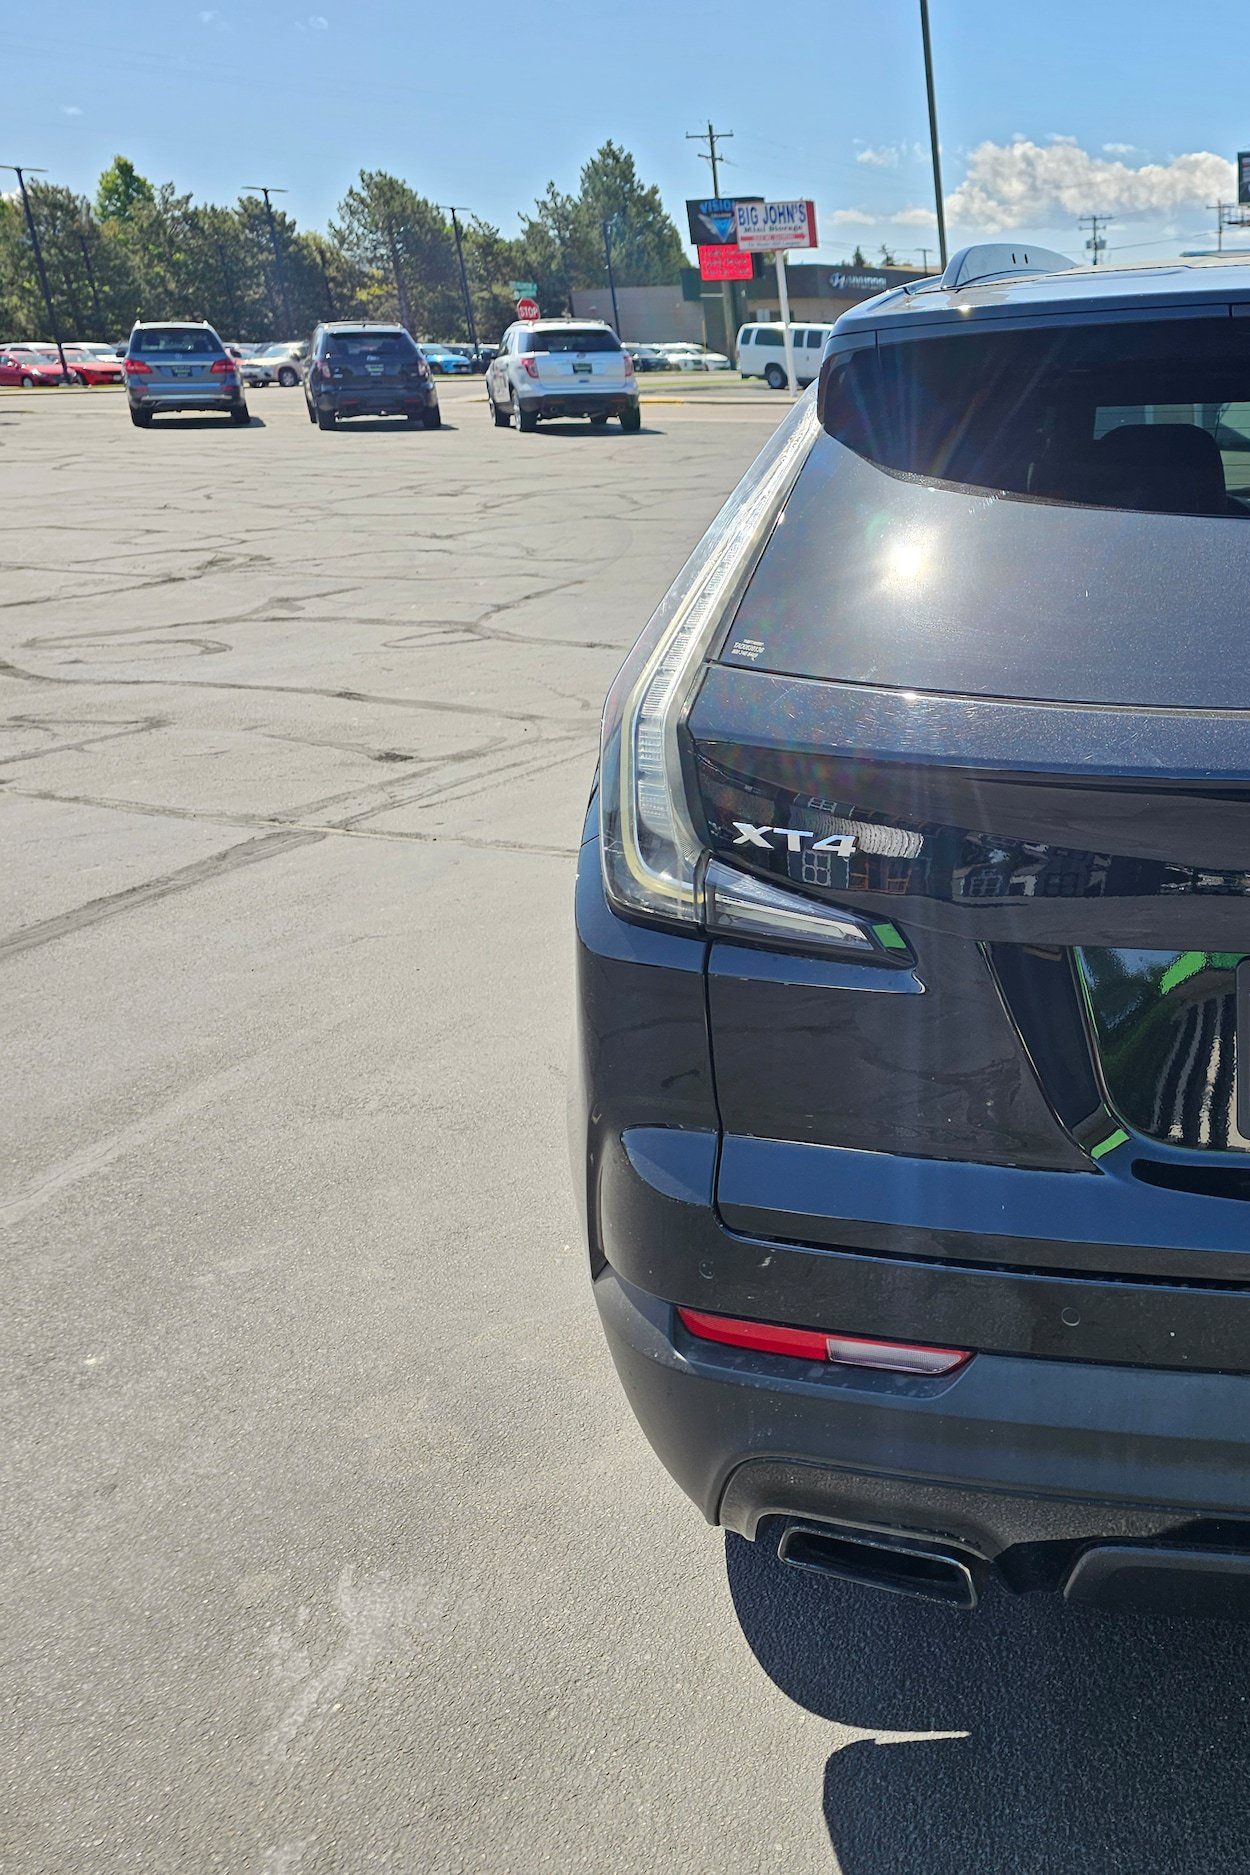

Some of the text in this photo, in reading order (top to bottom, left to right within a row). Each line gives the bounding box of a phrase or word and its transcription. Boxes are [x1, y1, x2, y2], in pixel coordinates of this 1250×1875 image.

[738, 203, 806, 226] BIG JOHN'S
[519, 306, 538, 318] STOP
[732, 821, 857, 857] XT4
